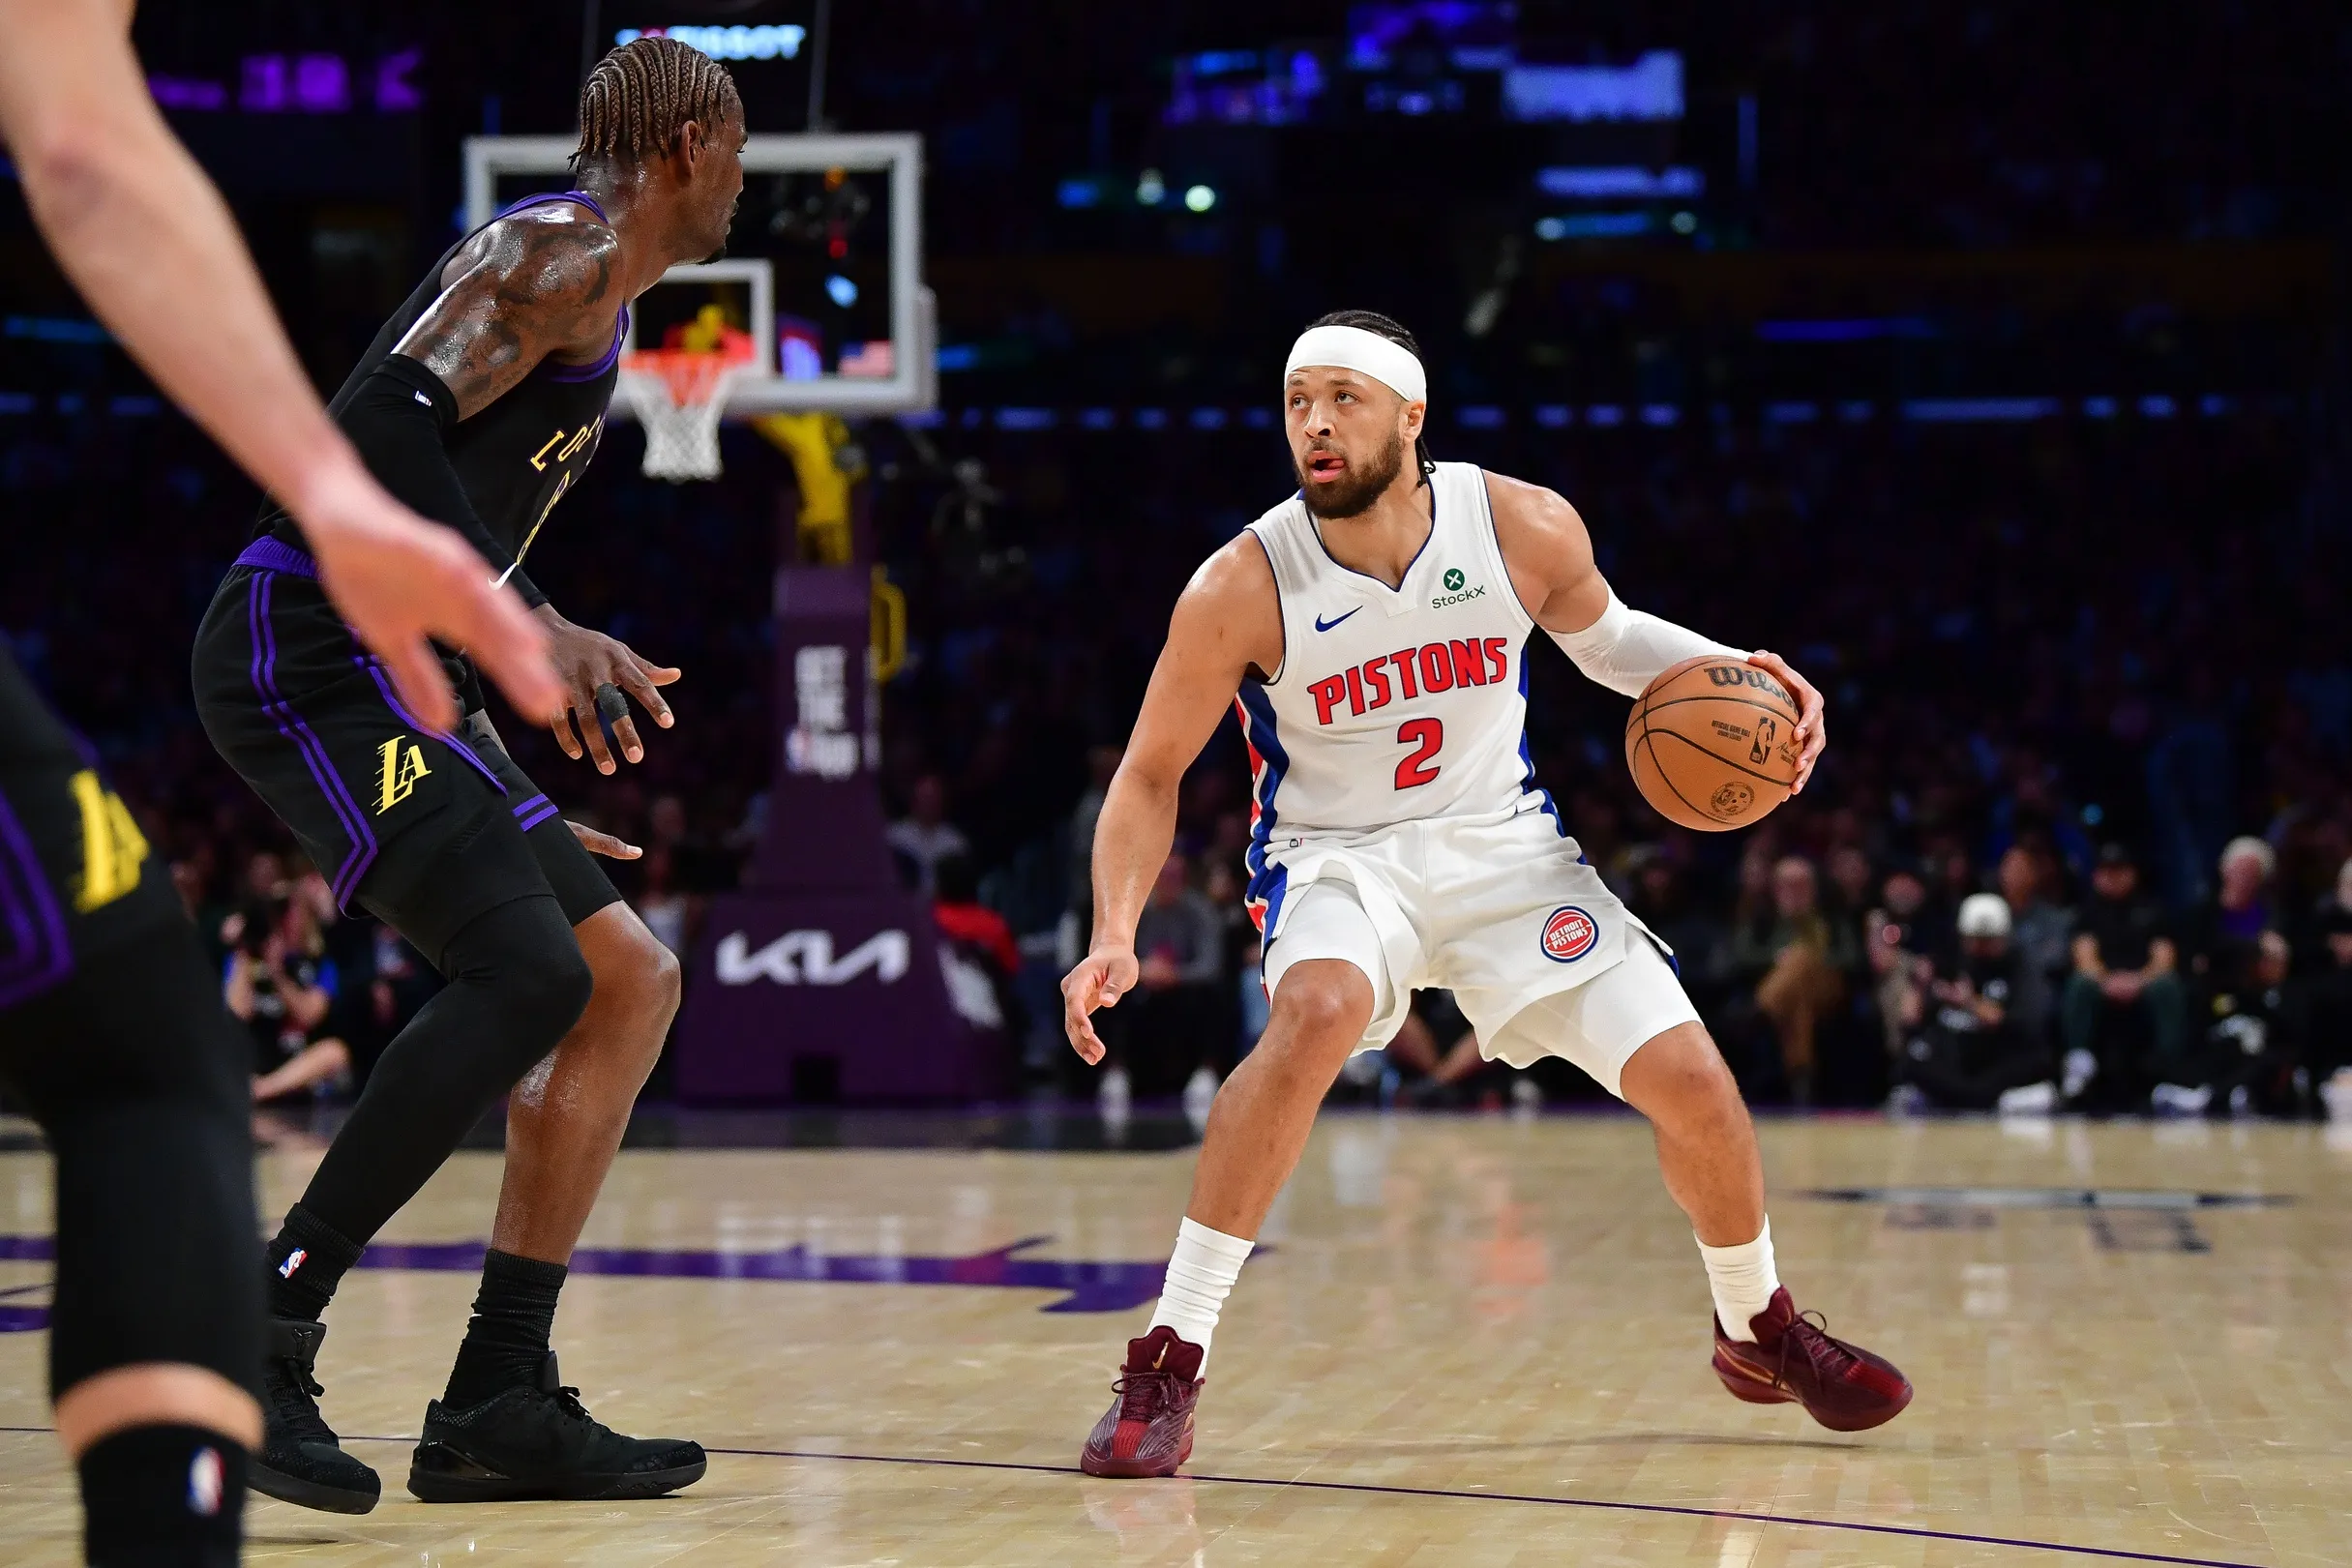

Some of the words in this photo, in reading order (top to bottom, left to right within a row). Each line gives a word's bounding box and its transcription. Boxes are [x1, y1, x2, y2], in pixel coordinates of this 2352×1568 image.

[1432, 585, 1486, 609] StockX
[1306, 637, 1507, 725] PISTONS
[372, 735, 432, 815] LA
[1394, 717, 1444, 791] 2
[1549, 919, 1584, 941] DETROIT
[1552, 927, 1588, 949] PISTONS
